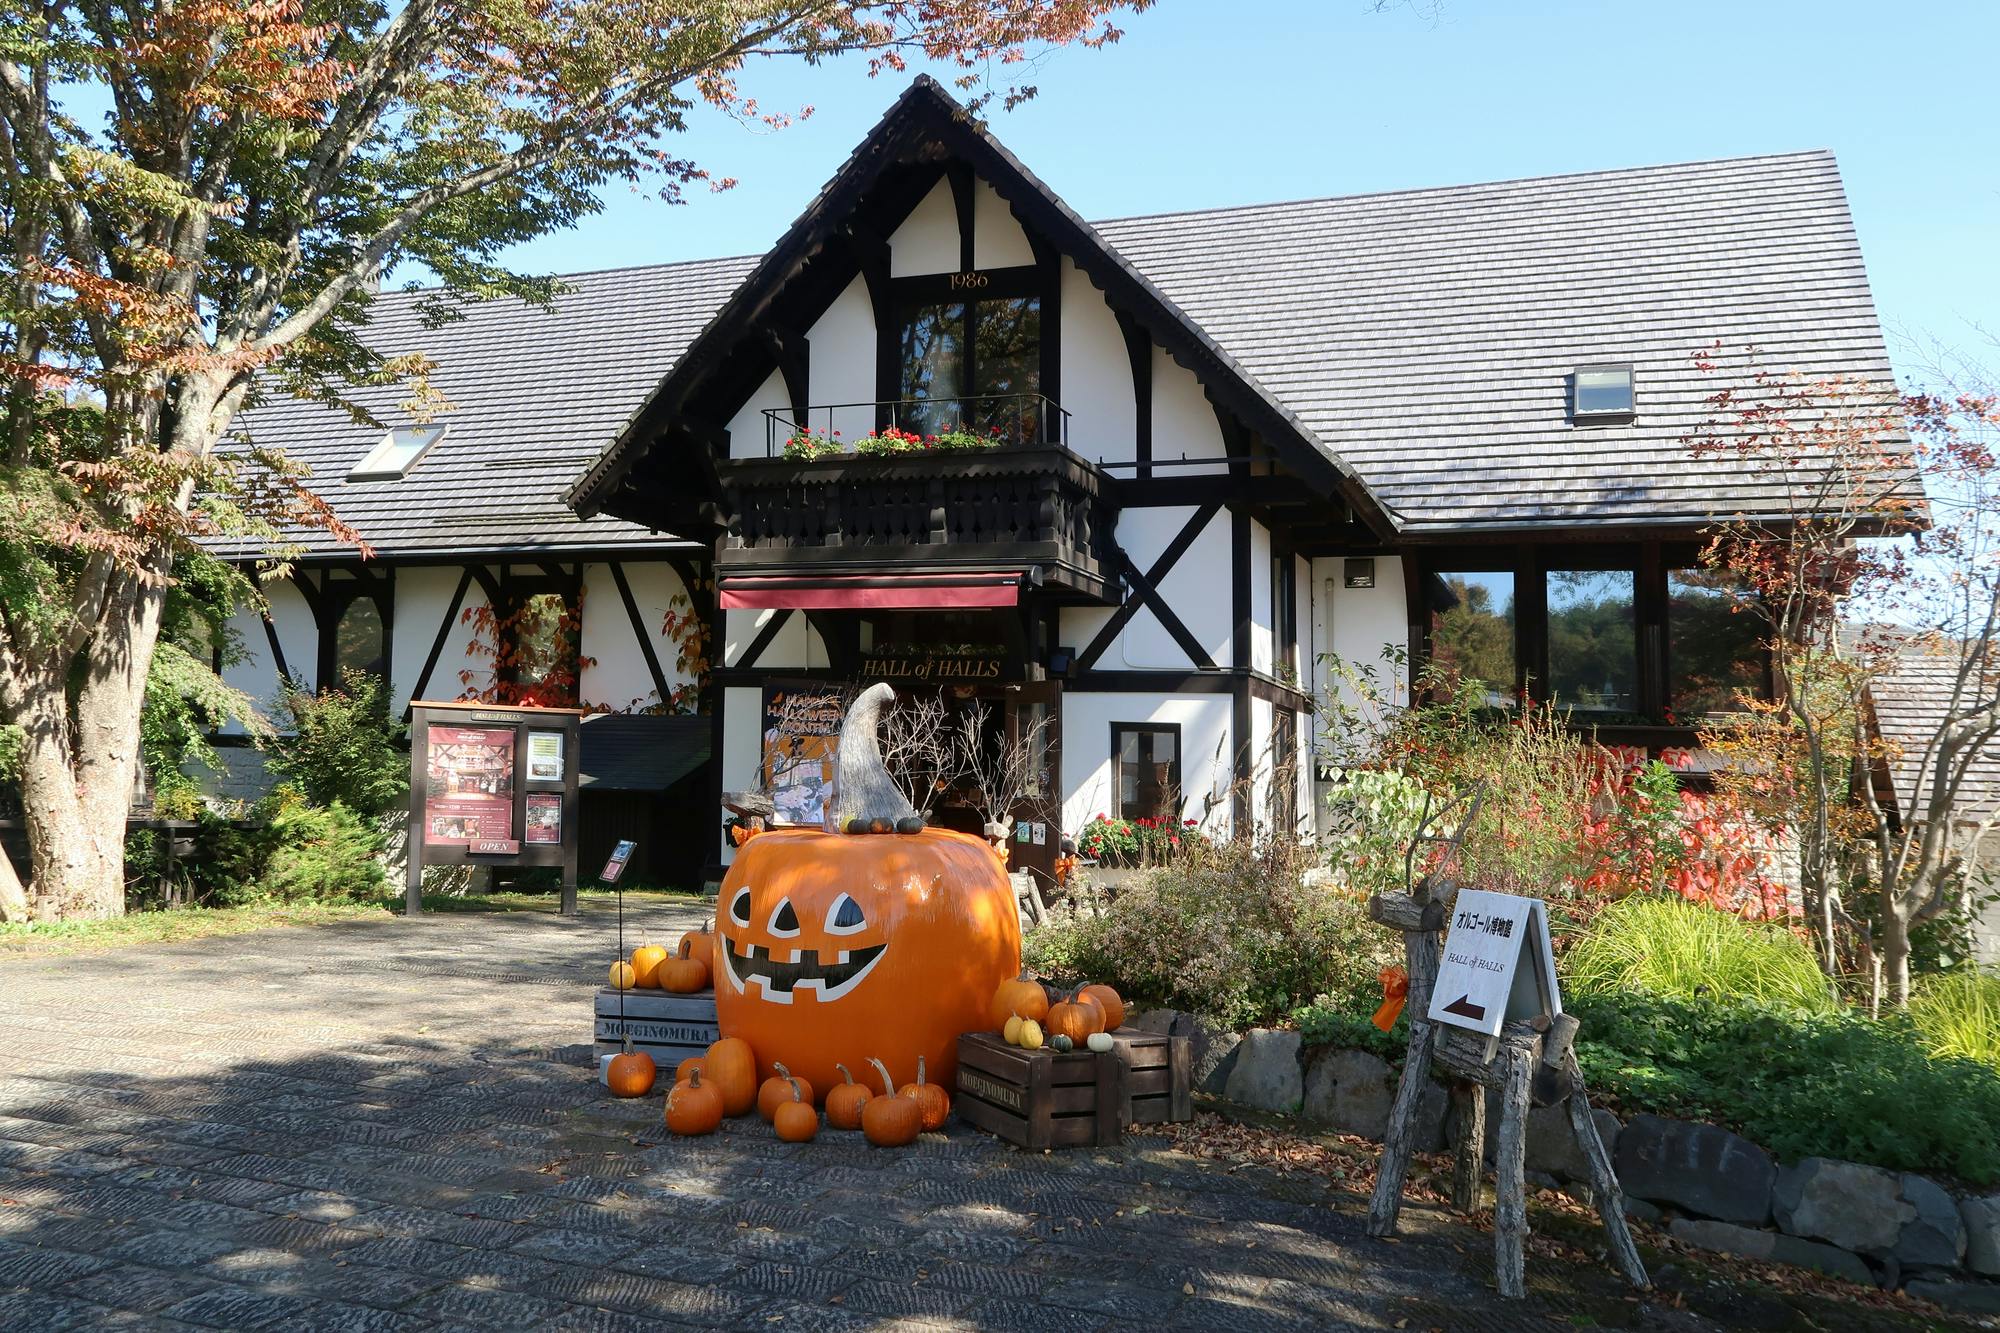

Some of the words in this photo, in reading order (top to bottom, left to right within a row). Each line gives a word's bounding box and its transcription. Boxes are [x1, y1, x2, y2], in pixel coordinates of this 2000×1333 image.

[950, 271, 988, 290] 1986
[863, 660, 912, 676] HALL
[915, 657, 934, 679] of
[938, 660, 1000, 677] HALLS
[480, 842, 509, 851] OPEN
[1456, 911, 1514, 938] オルゴール博物館
[1448, 952, 1468, 966] HALL
[1468, 956, 1478, 969] of
[1478, 959, 1505, 973] HALLS
[604, 1022, 709, 1041] MOEGINOMURA
